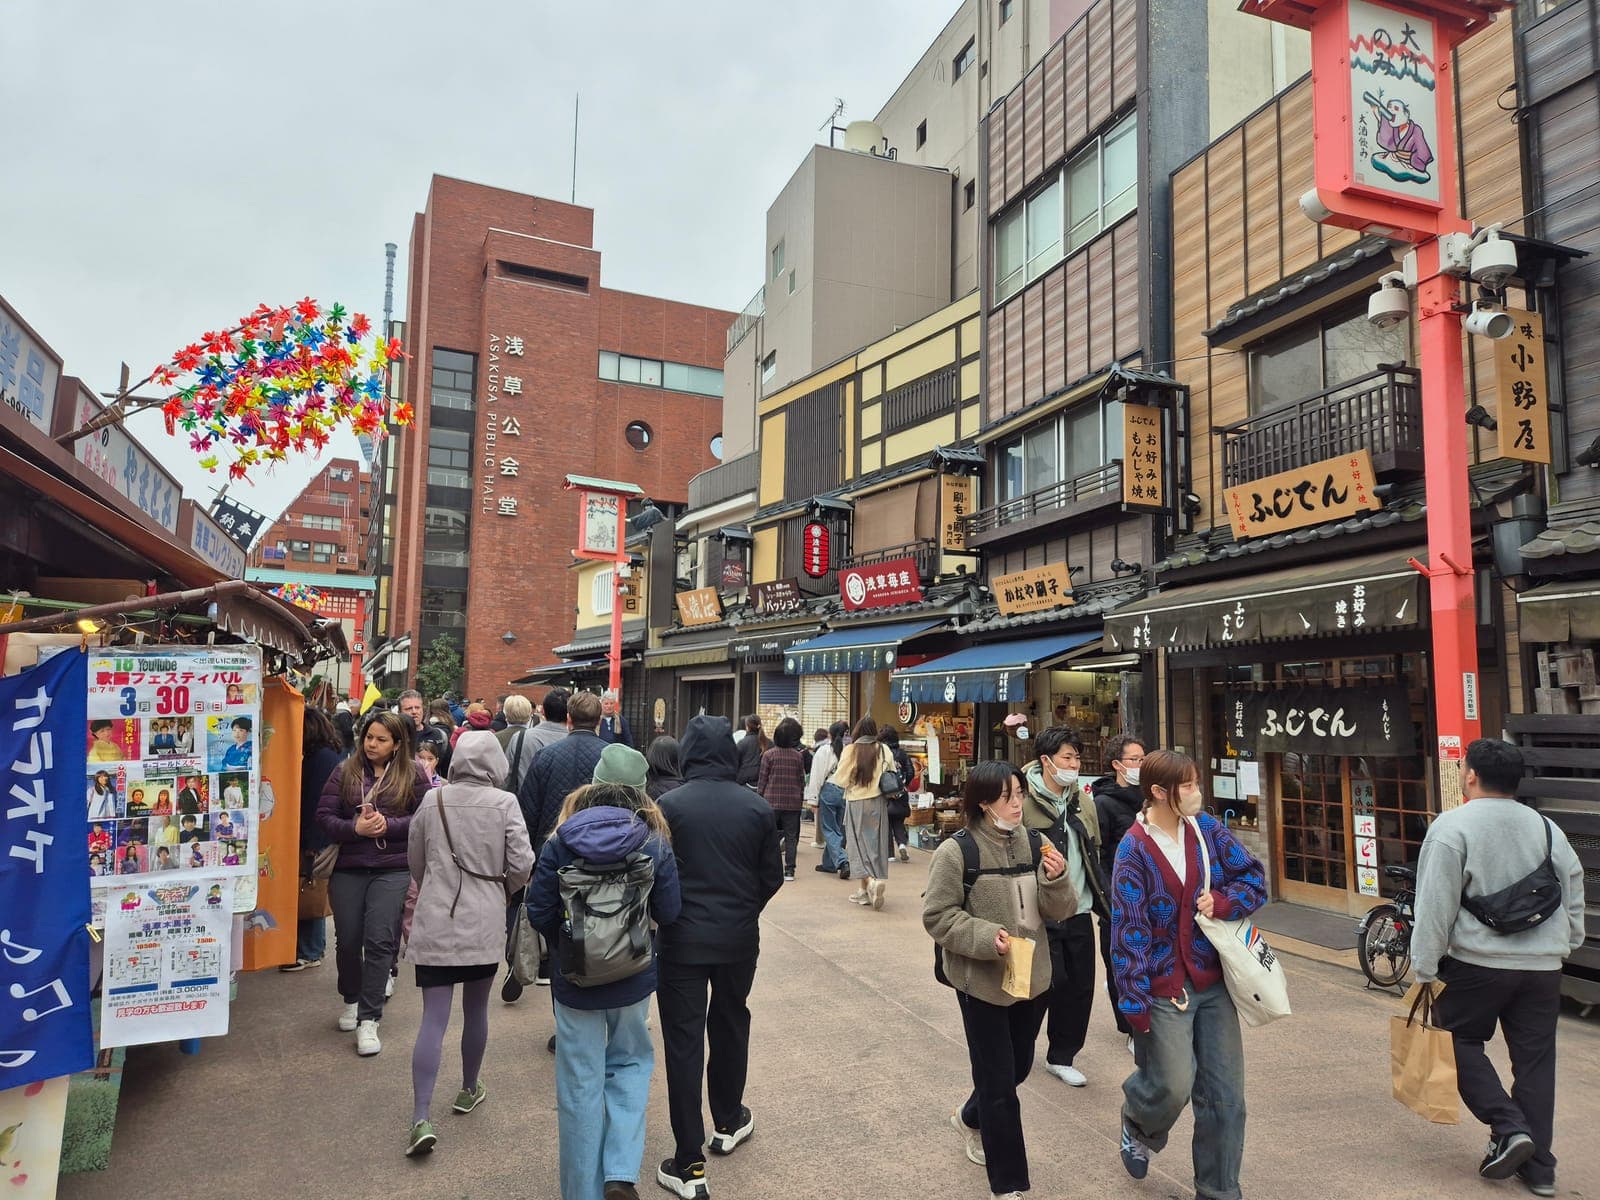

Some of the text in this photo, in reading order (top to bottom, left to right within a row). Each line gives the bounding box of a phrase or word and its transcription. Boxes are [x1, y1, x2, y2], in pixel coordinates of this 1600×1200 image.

[1373, 28, 1395, 76] のみ
[1400, 22, 1421, 78] 大竹
[1511, 344, 1537, 450] 小野屋
[482, 333, 501, 515] ASAKUSA PUBLIC HALL
[497, 335, 524, 517] 浅草公会堂
[1129, 416, 1156, 427] ふじでん
[1131, 431, 1144, 499] もんじゃ焼
[1145, 433, 1158, 500] お好み焼
[1350, 458, 1368, 505] お好み焼
[1249, 474, 1348, 523] ふじでん
[766, 598, 800, 612] パッション
[1222, 614, 1233, 641] でん
[1234, 602, 1245, 629] ふじ
[1335, 600, 1347, 629] 焼き
[1353, 585, 1367, 627] お好み
[1261, 707, 1357, 737] ふじでん
[7, 685, 54, 874] カラオケ
